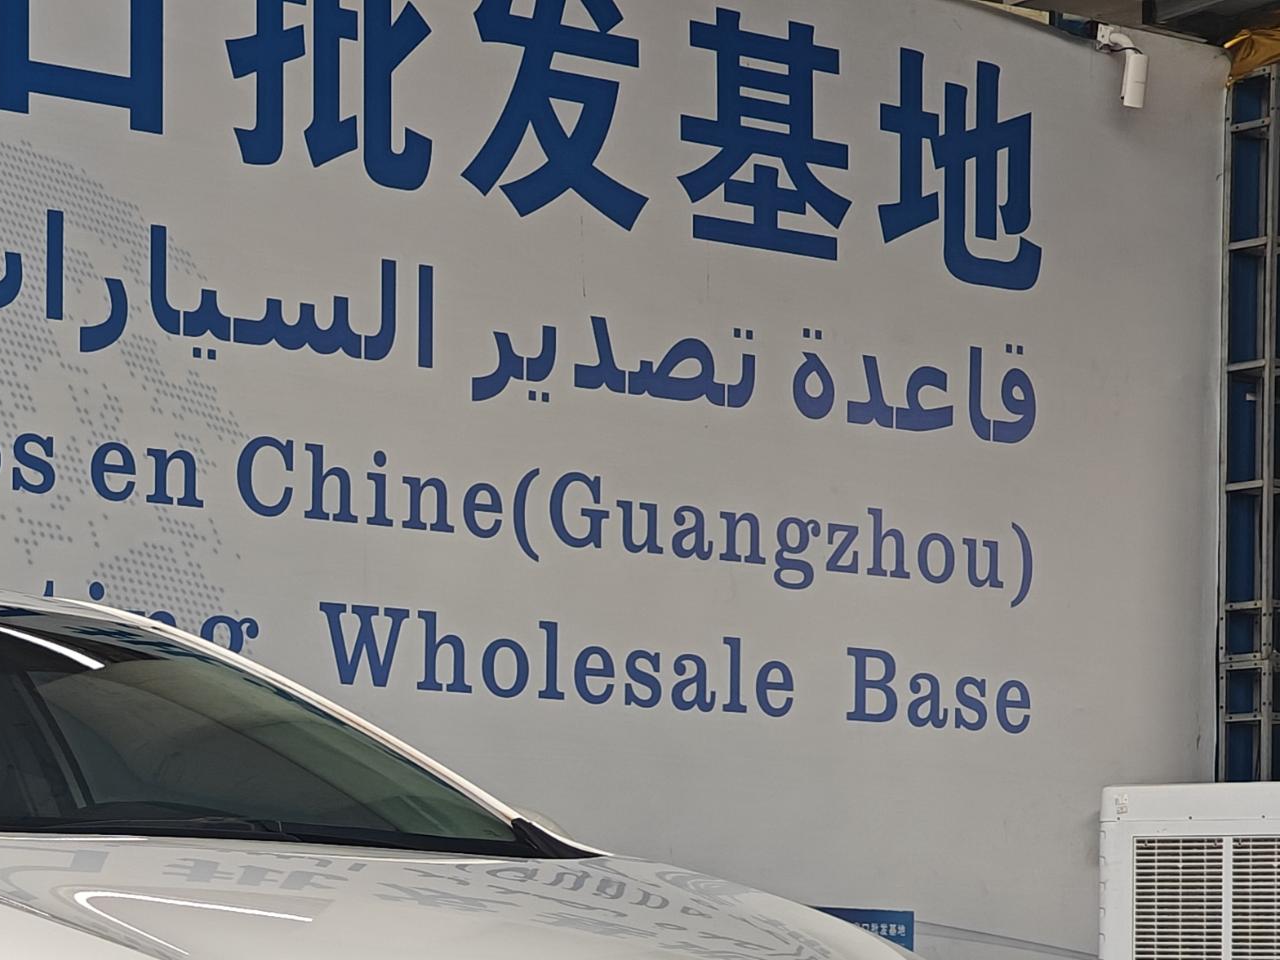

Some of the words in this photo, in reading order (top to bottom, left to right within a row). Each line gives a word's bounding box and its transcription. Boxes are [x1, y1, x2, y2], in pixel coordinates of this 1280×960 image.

[472, 315, 755, 405] تصدير
[792, 326, 1037, 443] قاعدة
[90, 441, 205, 509] en
[236, 435, 1034, 607] Chine(Guangzhou)
[320, 602, 795, 716] Wholesale
[846, 647, 1032, 733] Base
